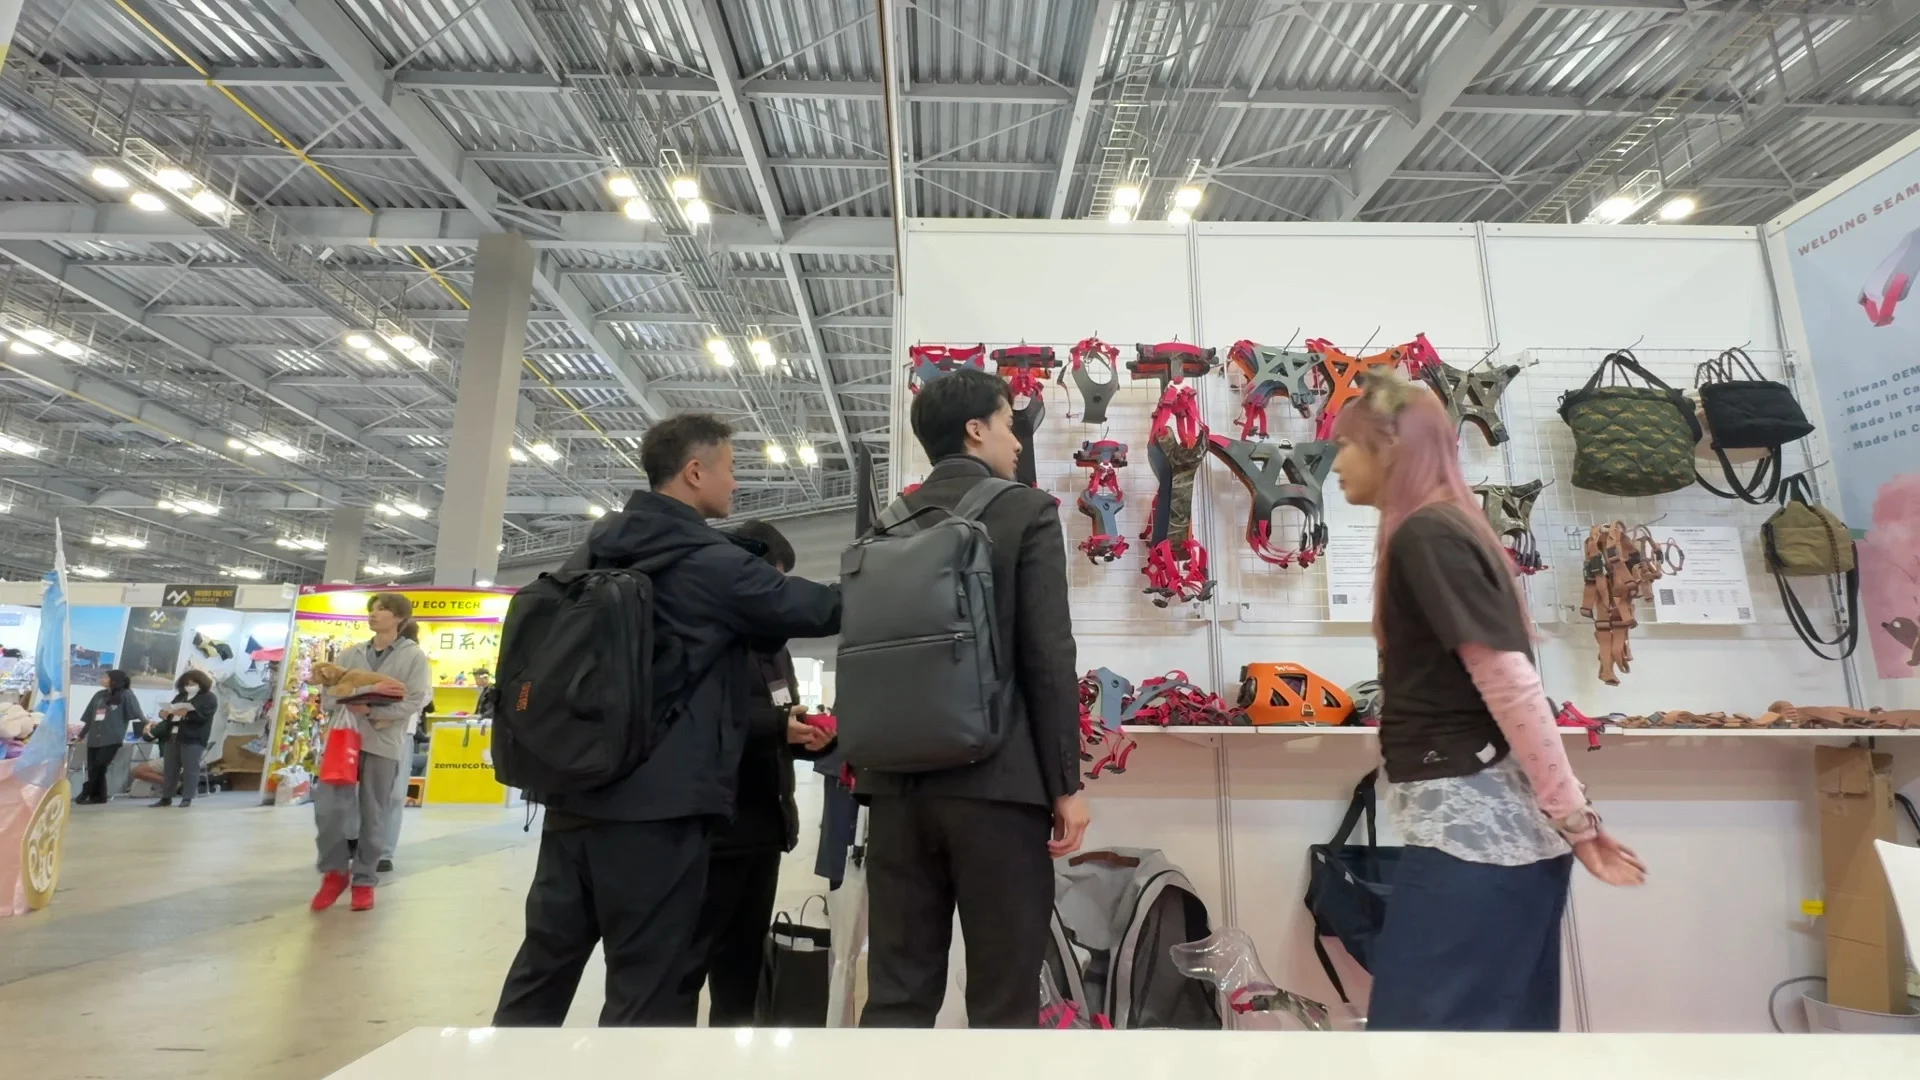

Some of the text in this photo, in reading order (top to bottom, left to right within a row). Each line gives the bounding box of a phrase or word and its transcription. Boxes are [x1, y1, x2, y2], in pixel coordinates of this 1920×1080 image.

[1798, 182, 1920, 256] WELDING SEAM
[1843, 365, 1920, 399] Taiwan OEM
[1846, 400, 1880, 415] Made
[1885, 393, 1898, 402] in
[1850, 417, 1885, 432] Made
[1889, 411, 1902, 420] in
[1853, 435, 1889, 450] Made
[1893, 429, 1906, 438] in
[423, 600, 446, 609] ECO
[450, 601, 480, 609] TECH
